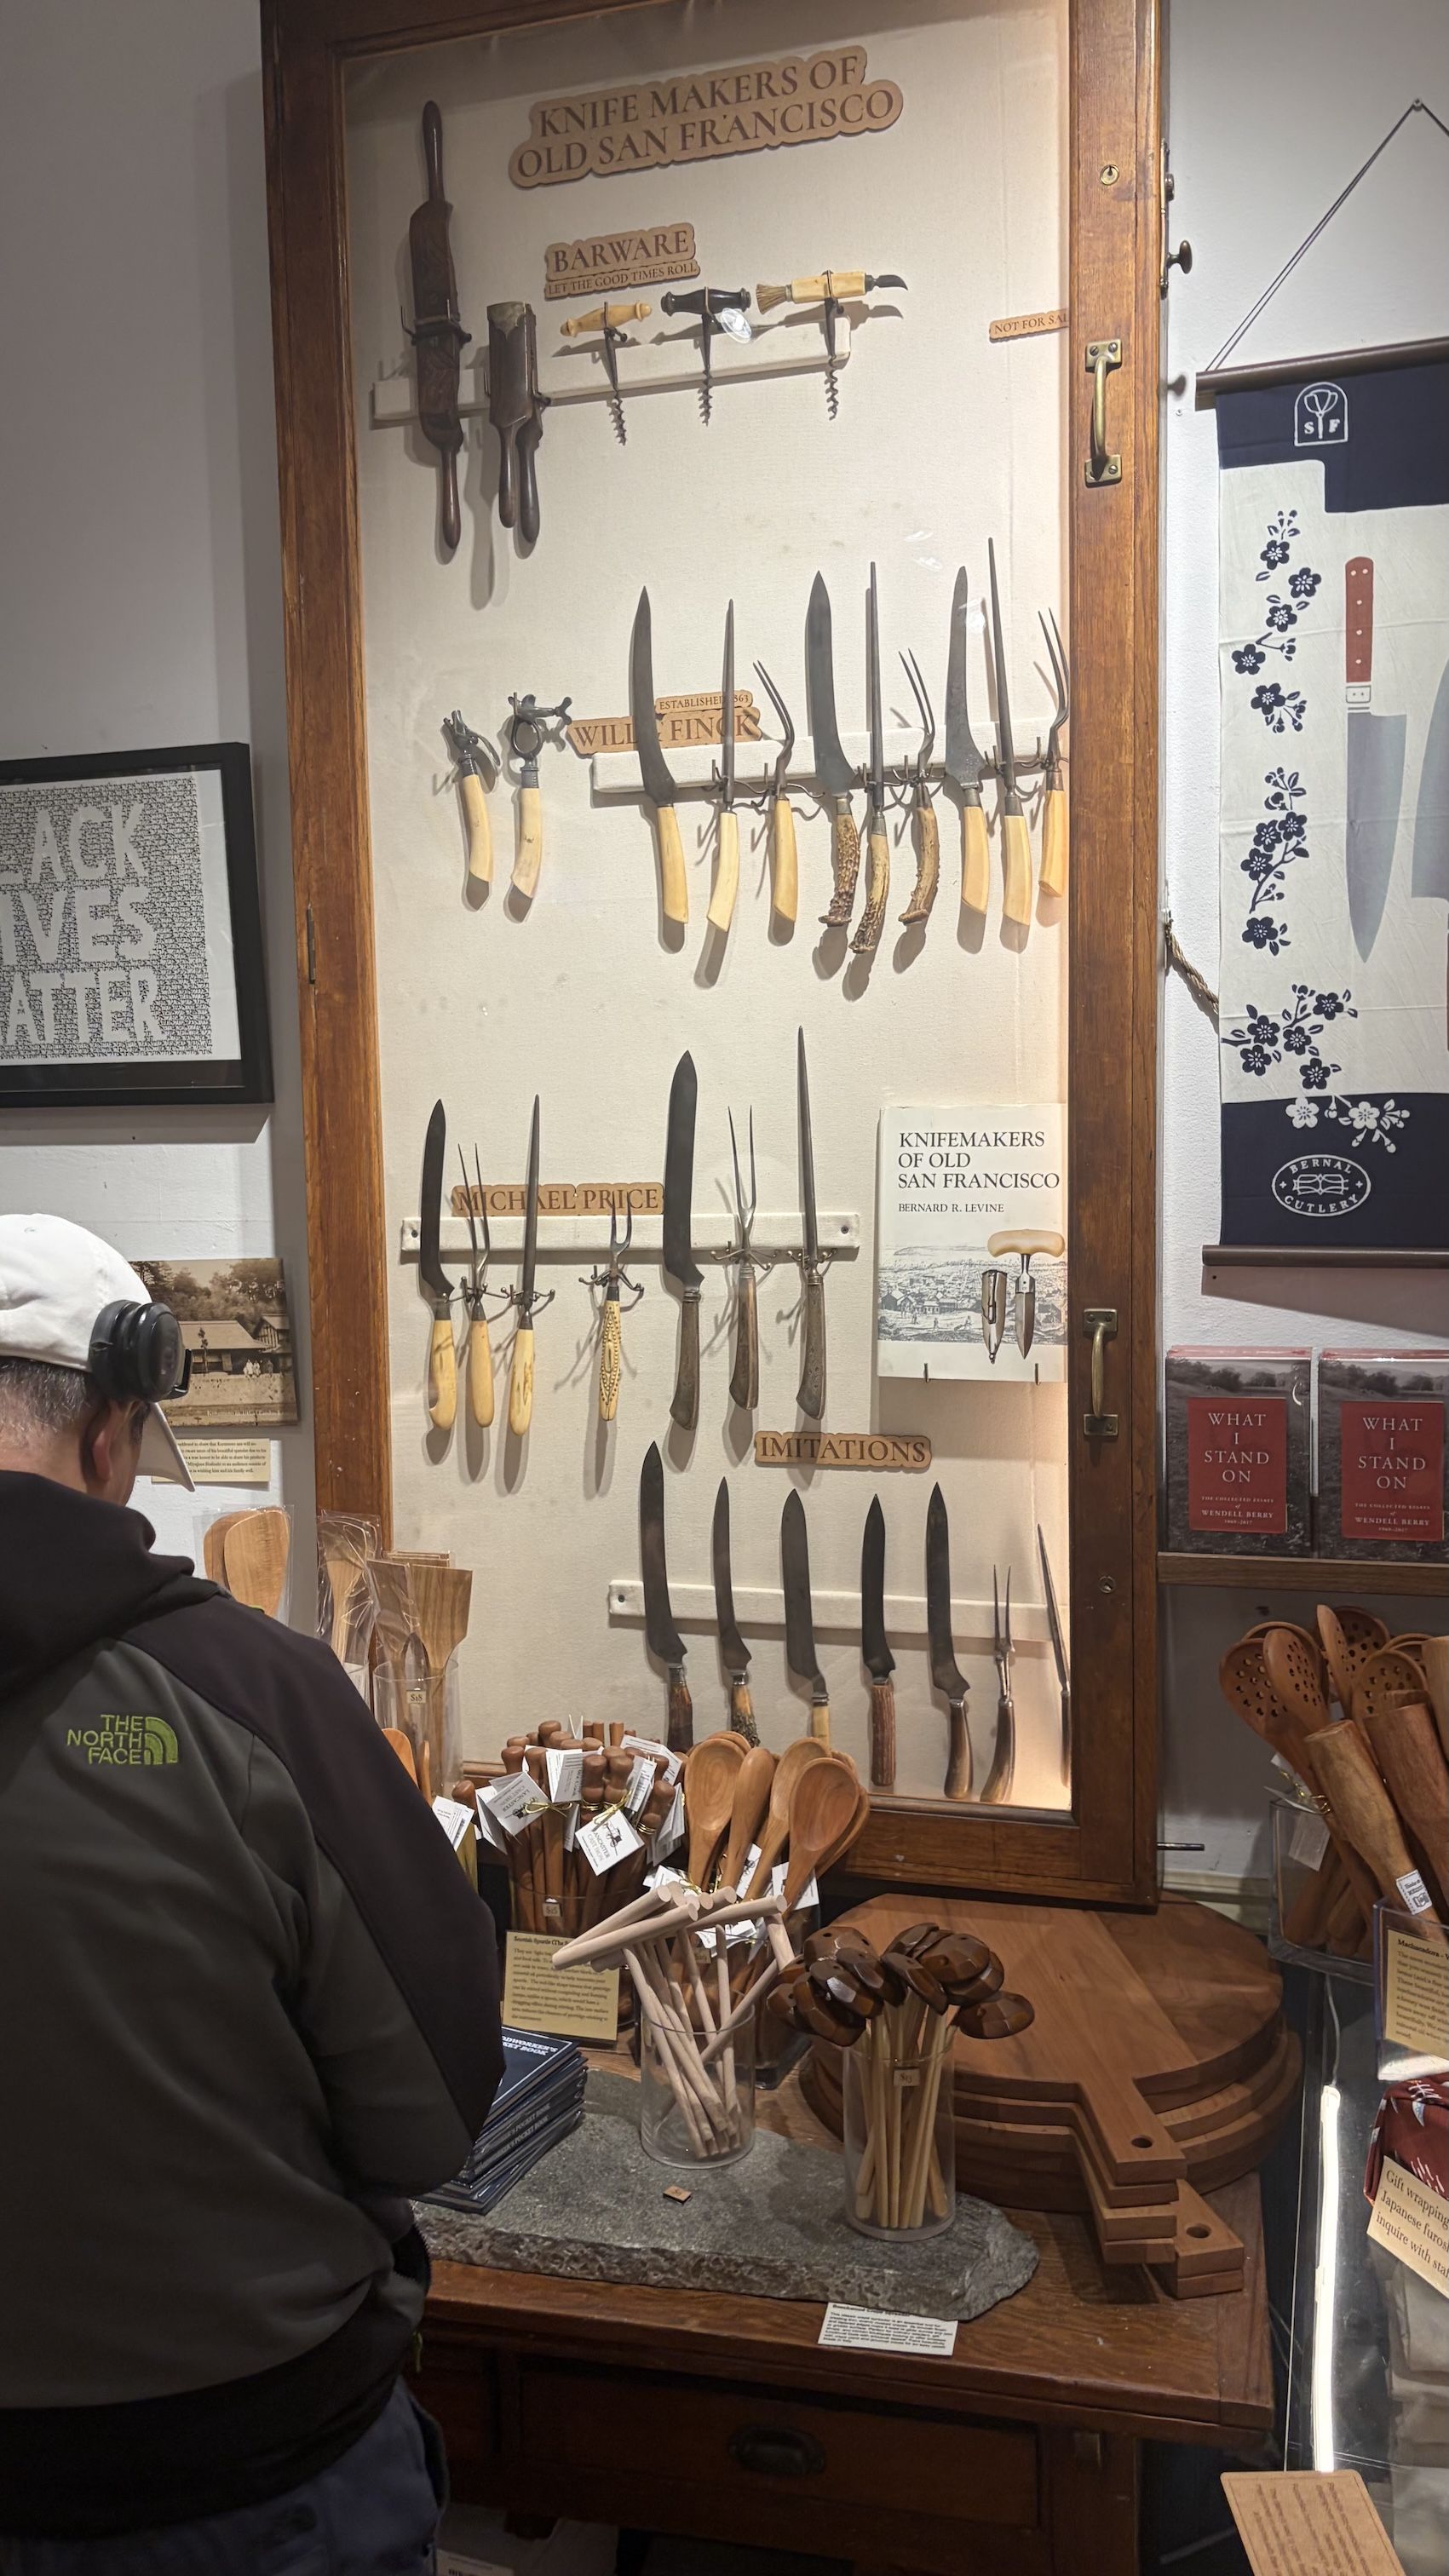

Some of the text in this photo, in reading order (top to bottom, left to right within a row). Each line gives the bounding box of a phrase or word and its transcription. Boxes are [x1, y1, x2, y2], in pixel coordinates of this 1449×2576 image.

[539, 55, 859, 137] KNIFE MAKERS OF
[517, 89, 894, 179] OLD SAN FRANCISCO
[554, 230, 689, 273] BARWARE
[548, 262, 697, 295] LET THE GOOD TIMES ROLL
[994, 313, 1067, 334] NOT FOR SAL
[1304, 418, 1340, 434] S F
[659, 696, 724, 710] ESTABLISHE
[0, 803, 150, 887] ACK
[0, 886, 158, 964] IVES
[0, 968, 170, 1045] ATTER
[900, 1131, 1045, 1147] KNIFEMAKERS
[898, 1153, 971, 1168] OF OLD
[1289, 1159, 1352, 1174] BERNAL
[898, 1172, 1060, 1189] SAN FRANCISCO
[583, 1188, 658, 1210] PRICE
[1284, 1193, 1358, 1213] CUTLERY
[899, 1203, 1004, 1213] BERNARD R. LEVINE
[1208, 1412, 1266, 1427] WHAT
[1363, 1417, 1423, 1431] WHAT
[1234, 1432, 1239, 1445] I
[1389, 1437, 1394, 1450] I
[761, 1437, 925, 1462] IMITATIONS
[1205, 1451, 1269, 1465] STAND
[1358, 1456, 1426, 1471] STAND
[1222, 1469, 1251, 1483] ON
[1377, 1475, 1406, 1490] ON
[1354, 1516, 1397, 1525] WENDELL
[101, 1714, 143, 1732] THE
[66, 1728, 142, 1749] NORTH
[88, 1747, 142, 1765] FACE
[502, 2036, 559, 2052] DWORKER'S
[520, 2045, 549, 2056] BOOK
[1386, 2169, 1449, 2230] Gift wrapping
[1380, 2189, 1422, 2230] Japanese
[1376, 2211, 1408, 2245] inquire
[1410, 2240, 1431, 2264] with
